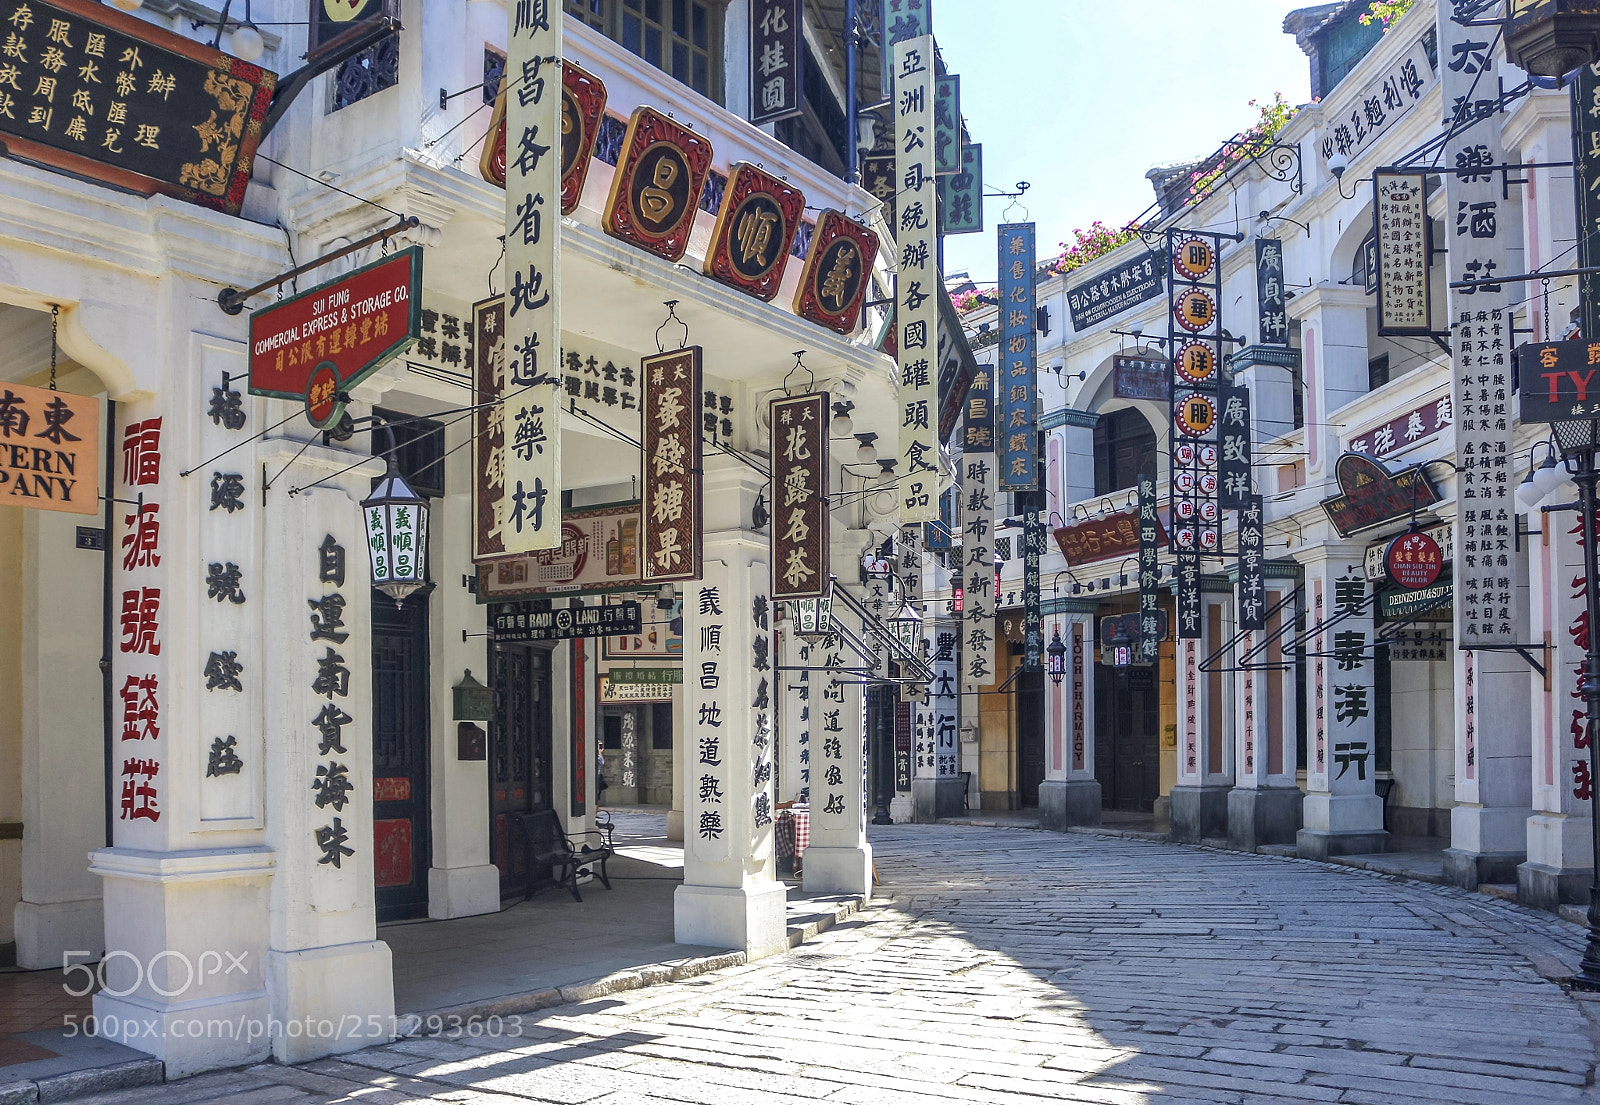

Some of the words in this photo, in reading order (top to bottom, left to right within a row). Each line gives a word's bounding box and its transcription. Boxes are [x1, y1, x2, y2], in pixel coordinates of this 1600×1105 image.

[28, 18, 73, 131] 服務周到
[64, 32, 106, 142] 匯水低廉
[135, 69, 176, 149] 辦理
[759, 1, 789, 111] 化桂圓
[640, 156, 678, 224] 昌
[255, 329, 300, 356] COMMERCIAL
[302, 311, 338, 338] EXPRESS
[341, 309, 348, 323] &
[350, 290, 391, 319] STORAGE
[394, 284, 409, 302] CO.
[313, 299, 325, 316] SUI
[328, 288, 350, 310] FUNG
[899, 50, 931, 509] 亞洲公司統辦各國罐頭食品
[1189, 245, 1208, 424] 明華洋服
[1259, 244, 1285, 337] 廣貞祥
[1222, 395, 1249, 500] 廣致祥
[1461, 374, 1475, 431] 水土不服
[371, 507, 387, 578] 義順昌
[393, 506, 413, 576] 義順昌
[782, 425, 816, 588] 花露名茶
[120, 415, 163, 823] 福源號錢莊
[204, 387, 247, 779] 福源號錢莊
[307, 533, 356, 869] 自運南貨海味
[699, 586, 724, 841] 義順昌地道熟藥
[1335, 576, 1370, 781] 美泰洋行
